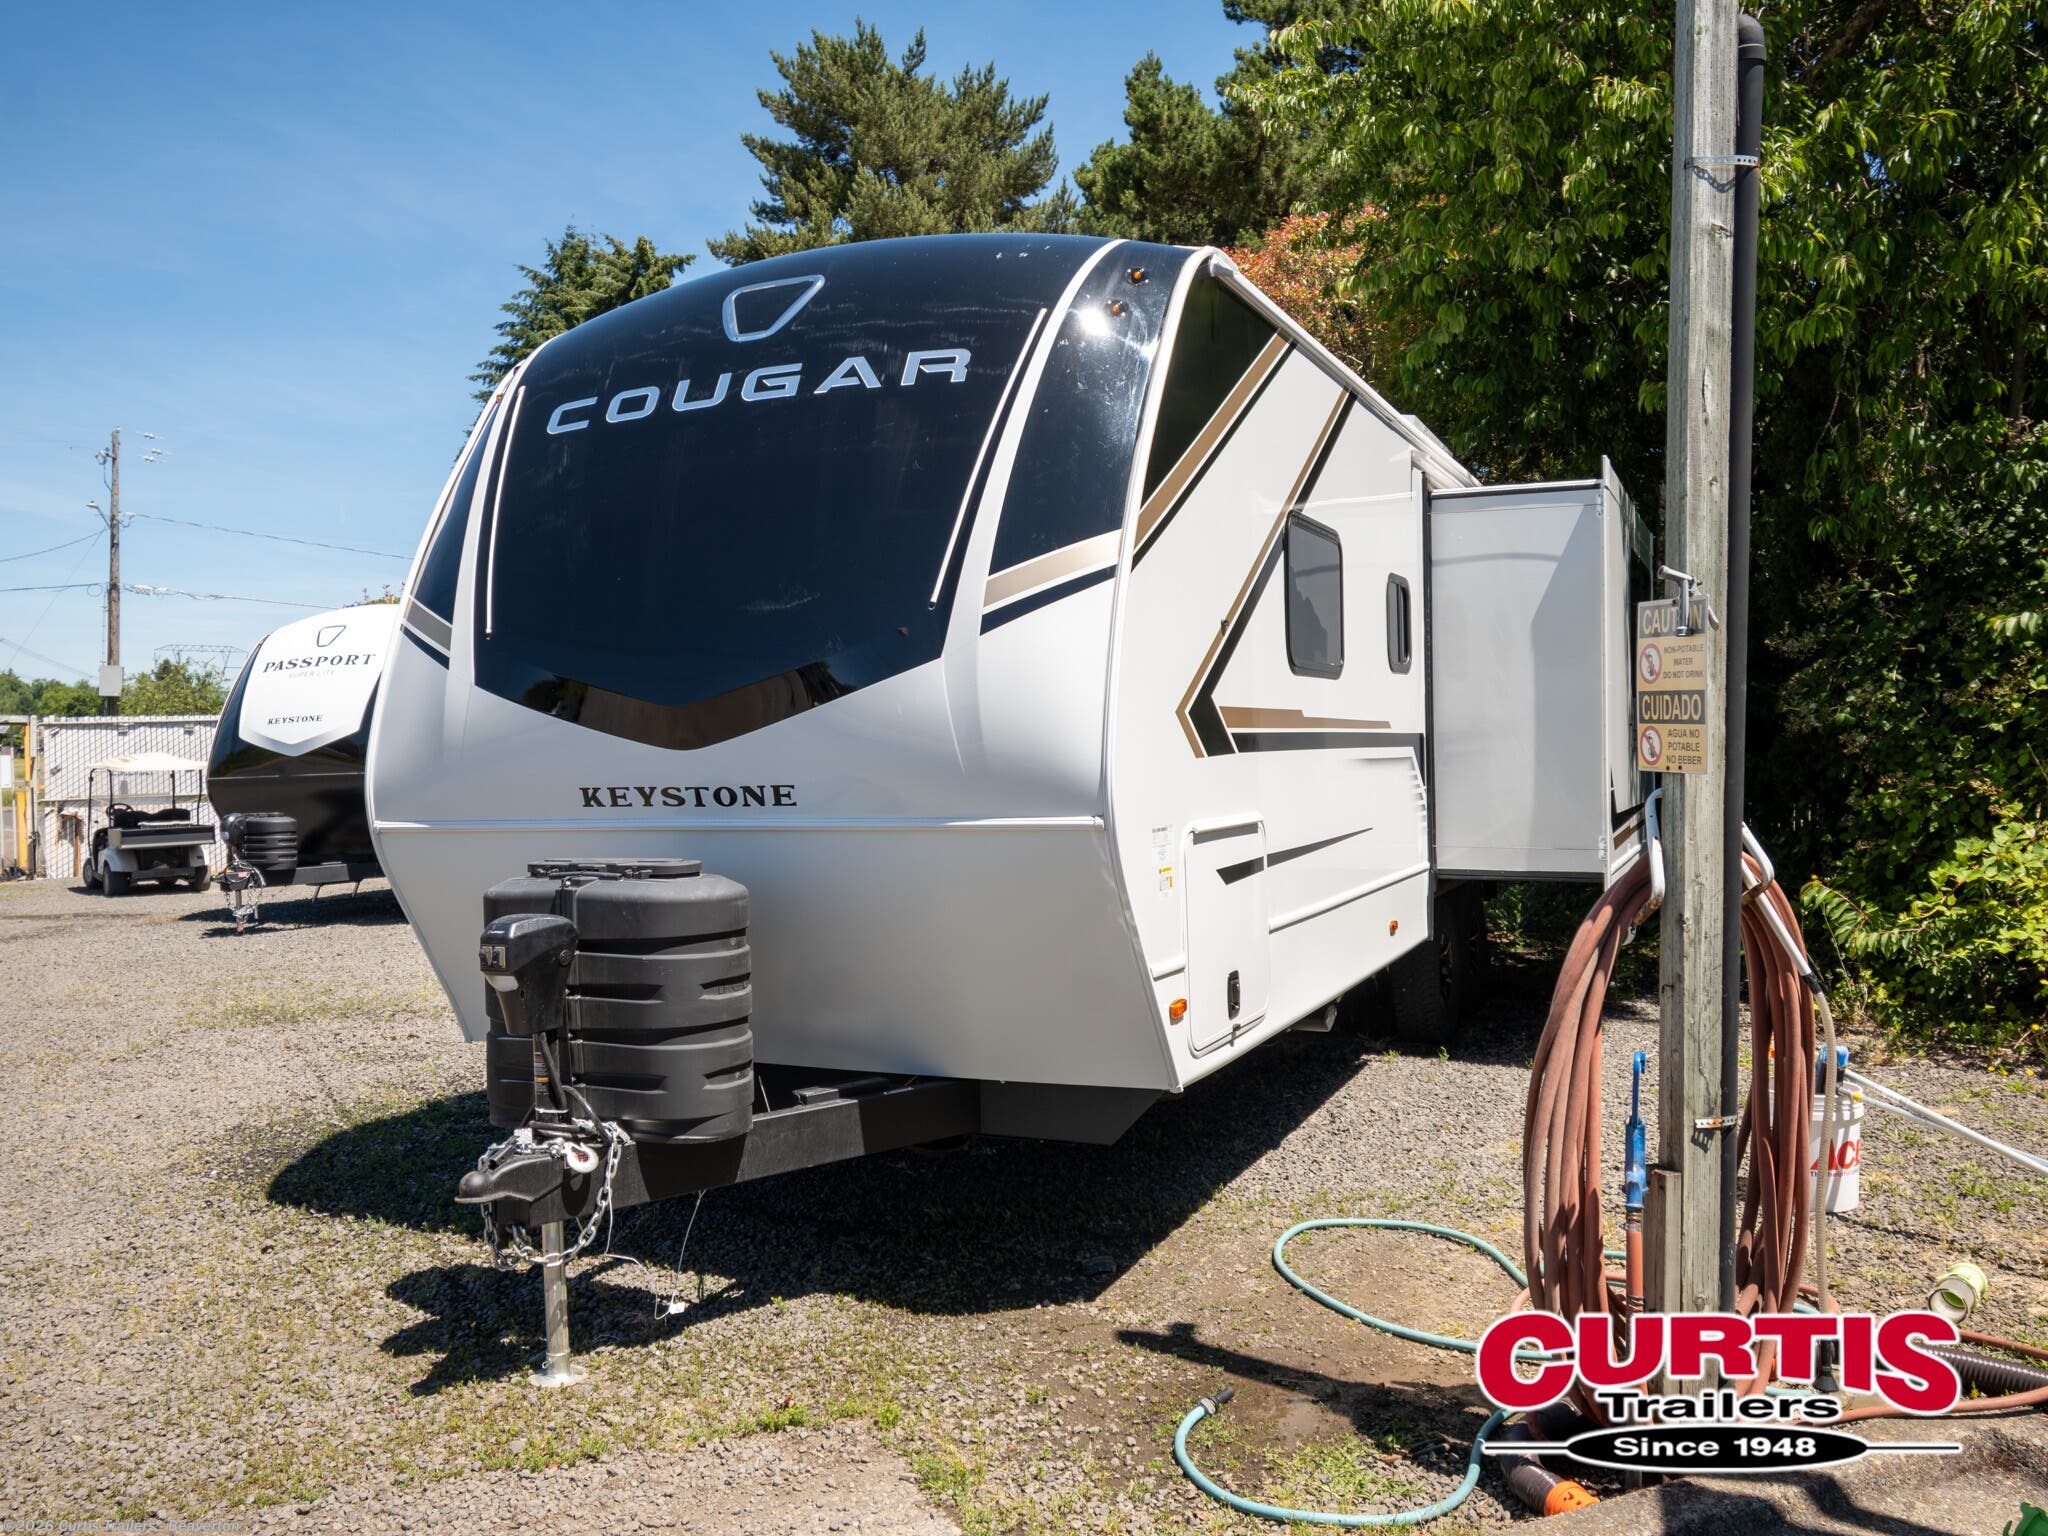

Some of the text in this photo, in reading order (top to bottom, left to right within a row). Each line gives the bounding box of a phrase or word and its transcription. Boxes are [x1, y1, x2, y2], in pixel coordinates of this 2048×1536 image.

[545, 347, 972, 435] COUGAR
[1643, 604, 1703, 634] CAUTN
[1663, 644, 1704, 654] NON-POTABLE
[263, 653, 377, 673] PASSPORT
[1673, 657, 1694, 666] WATER
[1663, 670, 1704, 679] DO NOT DRINK
[1642, 694, 1702, 720] CUIDADO
[267, 715, 324, 726] KEYSTONE
[1668, 728, 1700, 738] AGUA NO
[1668, 742, 1700, 752] POTABLE
[1666, 754, 1702, 765] NO BEBER
[578, 784, 798, 808] KEYSTONE
